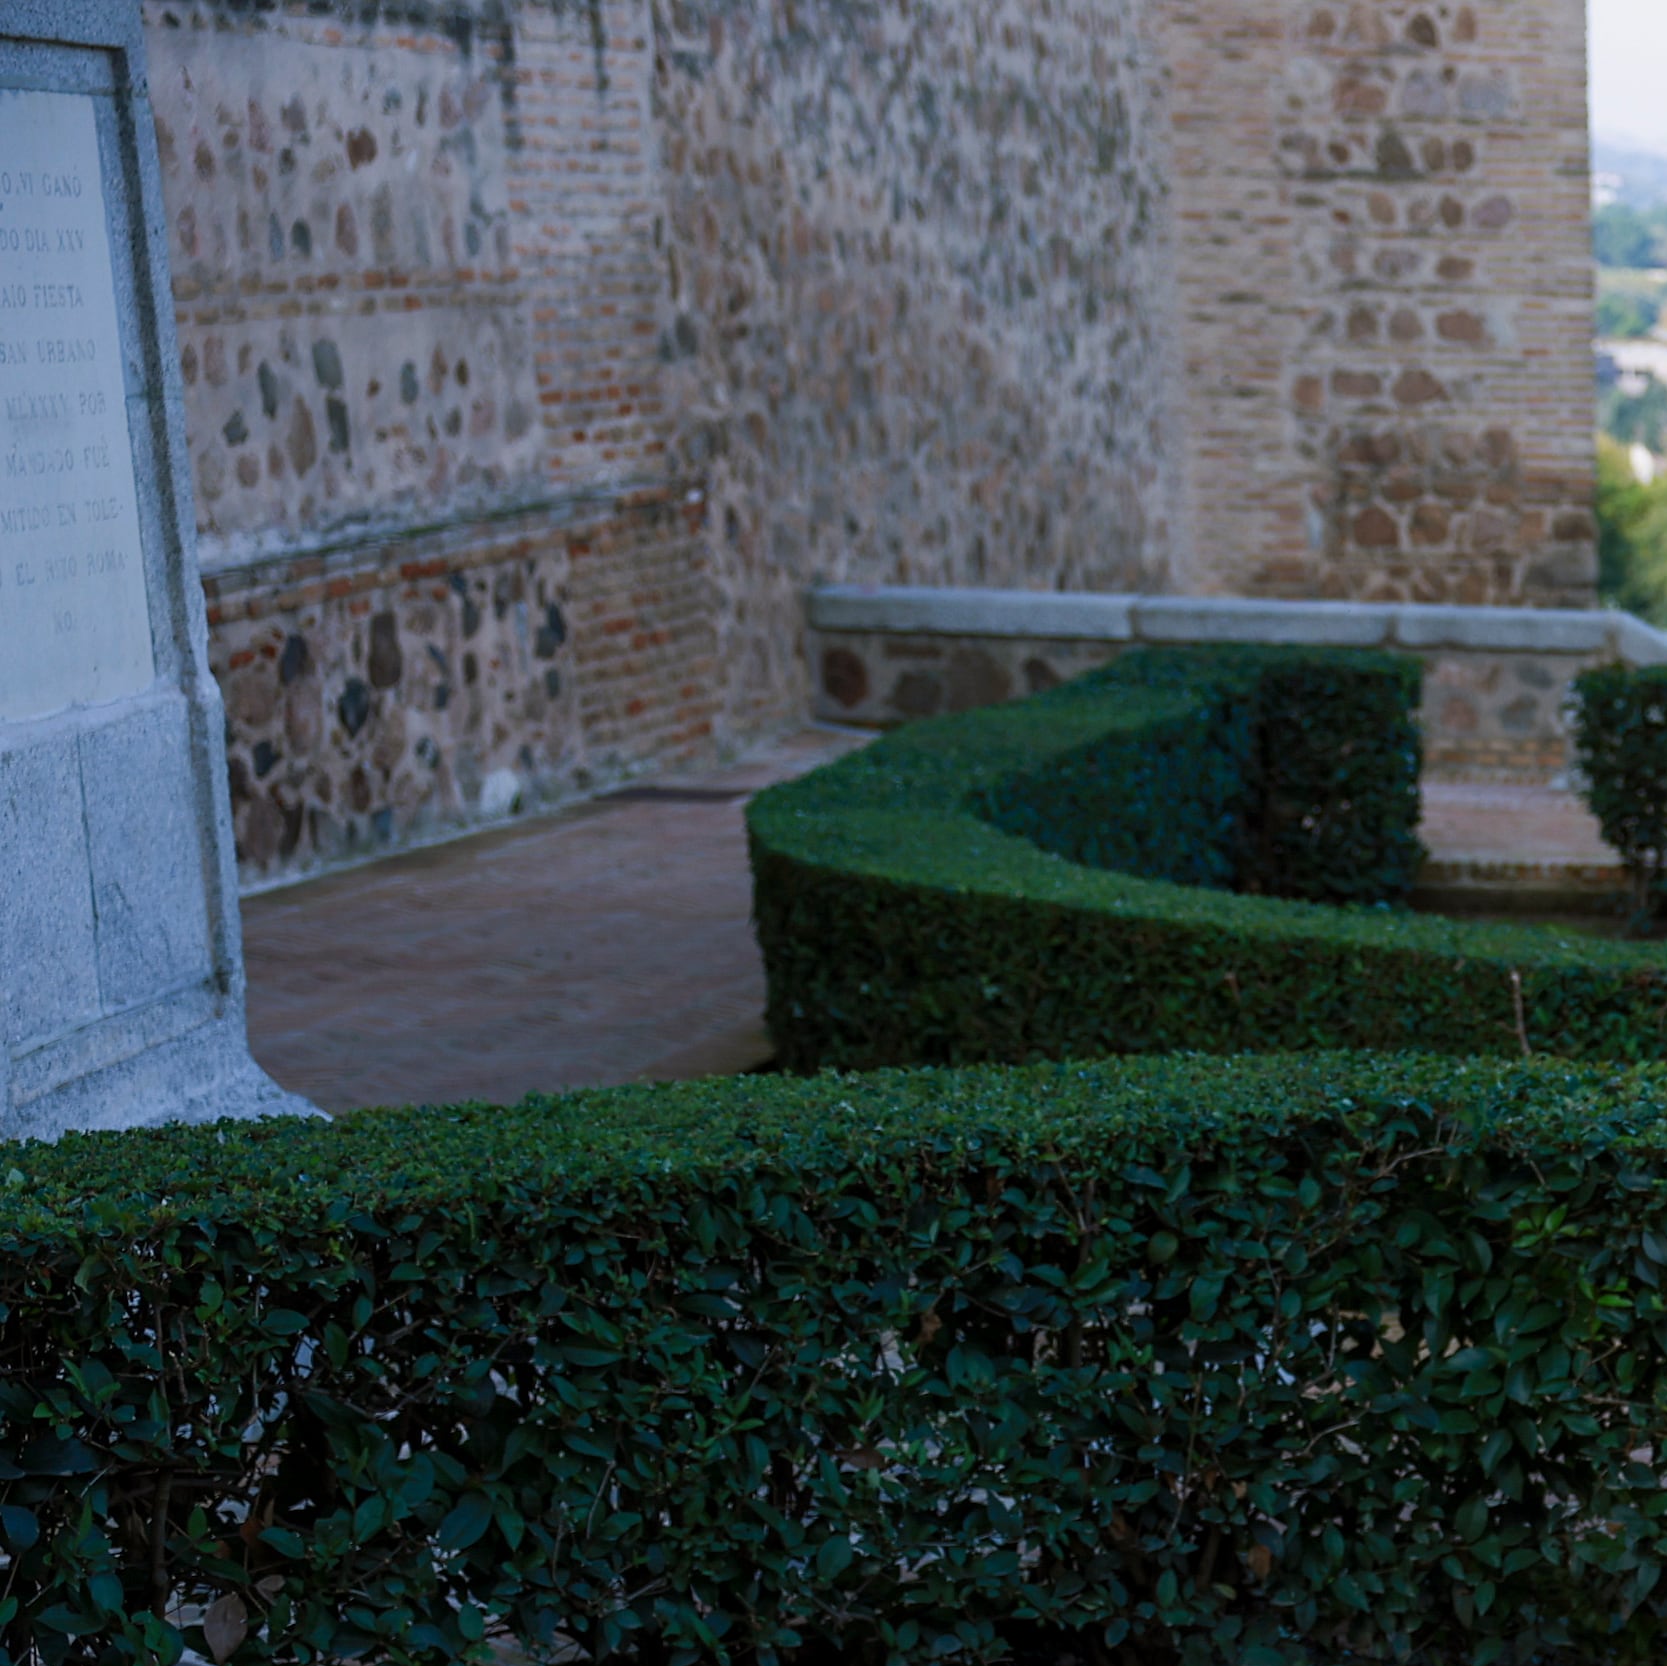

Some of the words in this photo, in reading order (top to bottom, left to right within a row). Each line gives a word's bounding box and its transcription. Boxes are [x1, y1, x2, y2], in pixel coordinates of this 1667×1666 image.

[41, 164, 82, 199] GANÓ
[32, 283, 84, 309] FIESTA
[36, 337, 96, 364] URBANO
[78, 390, 106, 416] POR
[57, 502, 78, 526] EN
[16, 561, 36, 586] EL
